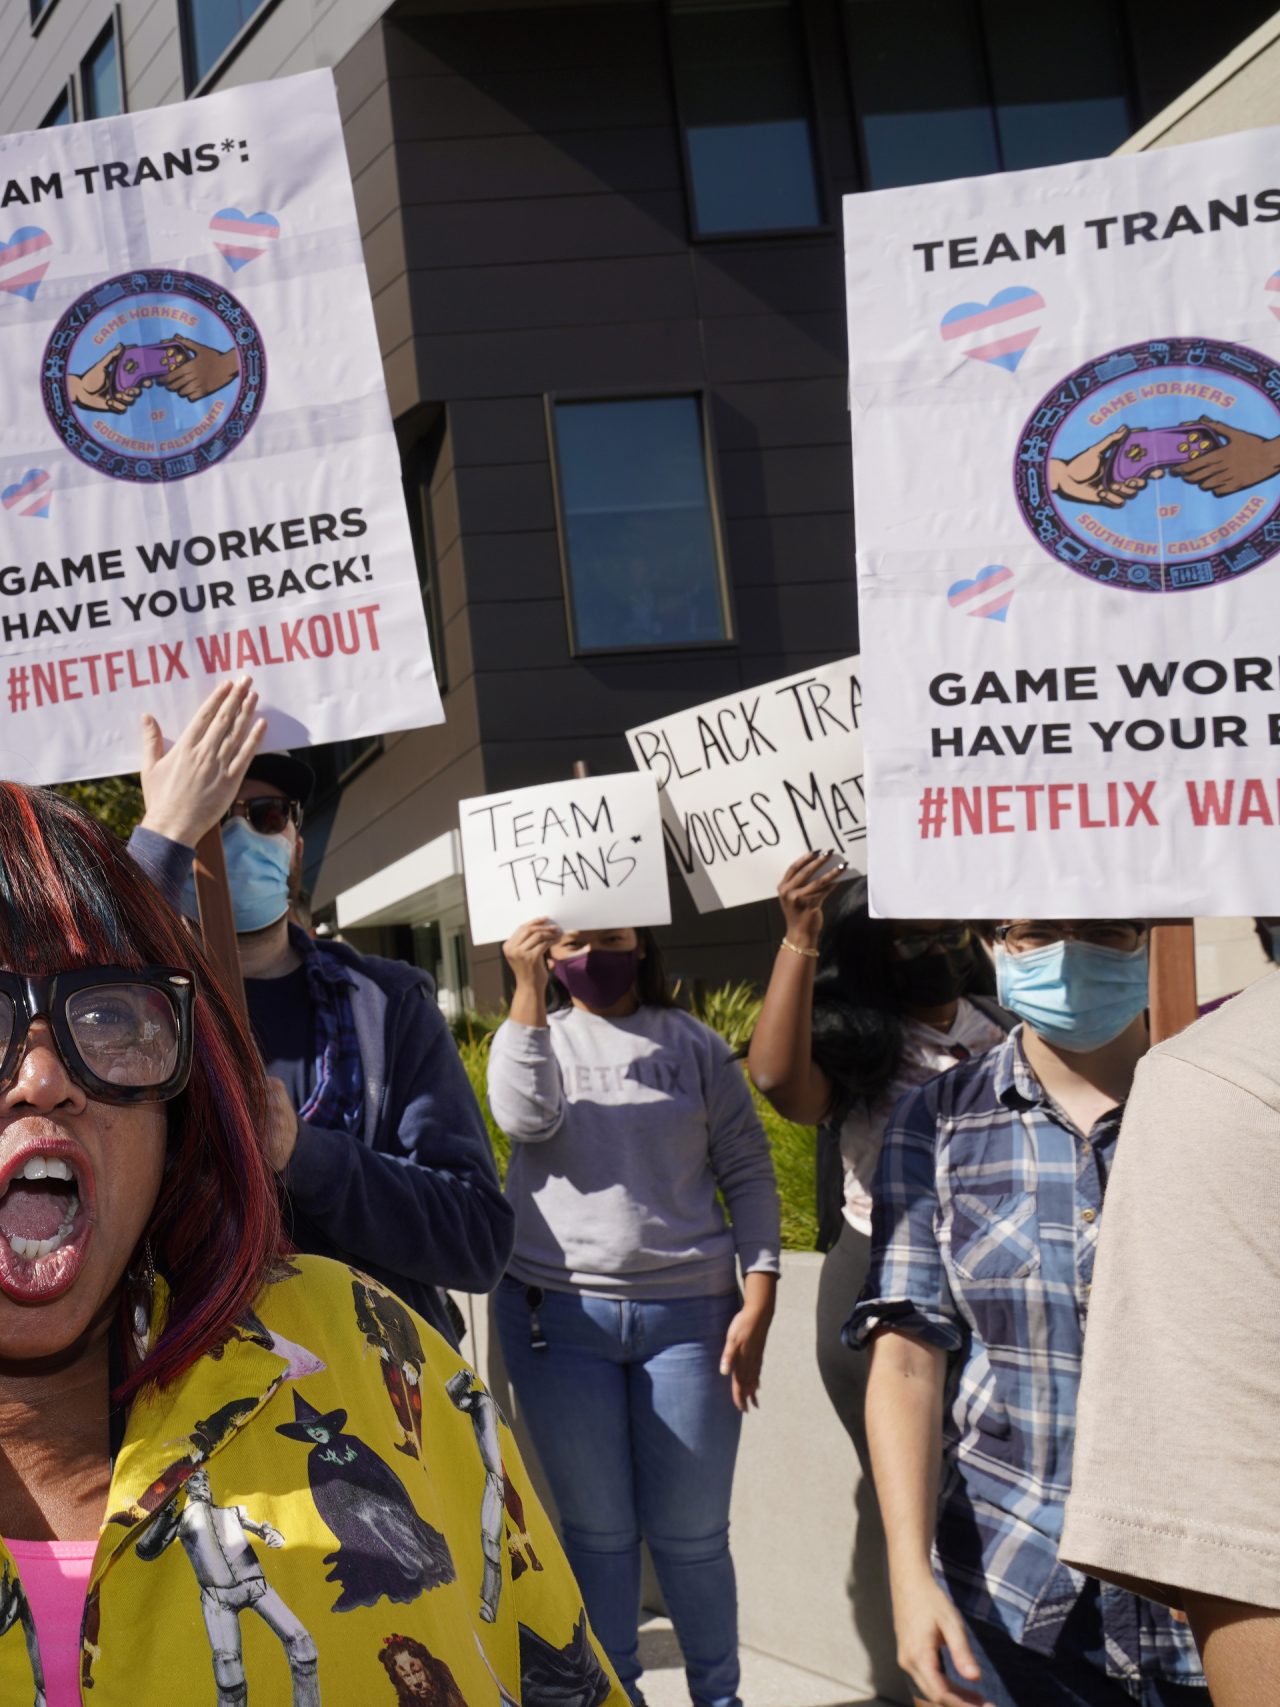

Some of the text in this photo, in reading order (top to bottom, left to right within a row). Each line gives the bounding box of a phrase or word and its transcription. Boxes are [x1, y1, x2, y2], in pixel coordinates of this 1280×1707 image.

[914, 188, 1280, 272] TEAM TRANS
[93, 306, 199, 345] GAME WORKERS
[94, 400, 225, 451] SOUTHERN CALIFORNIA
[151, 410, 165, 421] OF
[1088, 381, 1236, 426] GAME WORKERS
[1076, 496, 1265, 555] SOUTHERN CALIFORNIA
[1158, 505, 1180, 518] OF
[136, 508, 368, 574] WORKERS
[2, 554, 373, 642] HAVE YOUR BACK!
[7, 604, 381, 713] #NETFLIX WALKOUT
[930, 656, 1280, 707] GAME WOR
[634, 696, 778, 791] BLACK
[932, 724, 1073, 758] HAVE
[1089, 716, 1248, 752] YOUR
[469, 795, 615, 852] TEAM
[661, 791, 780, 875] VOICES
[919, 778, 1280, 839] #NETFLIX WA
